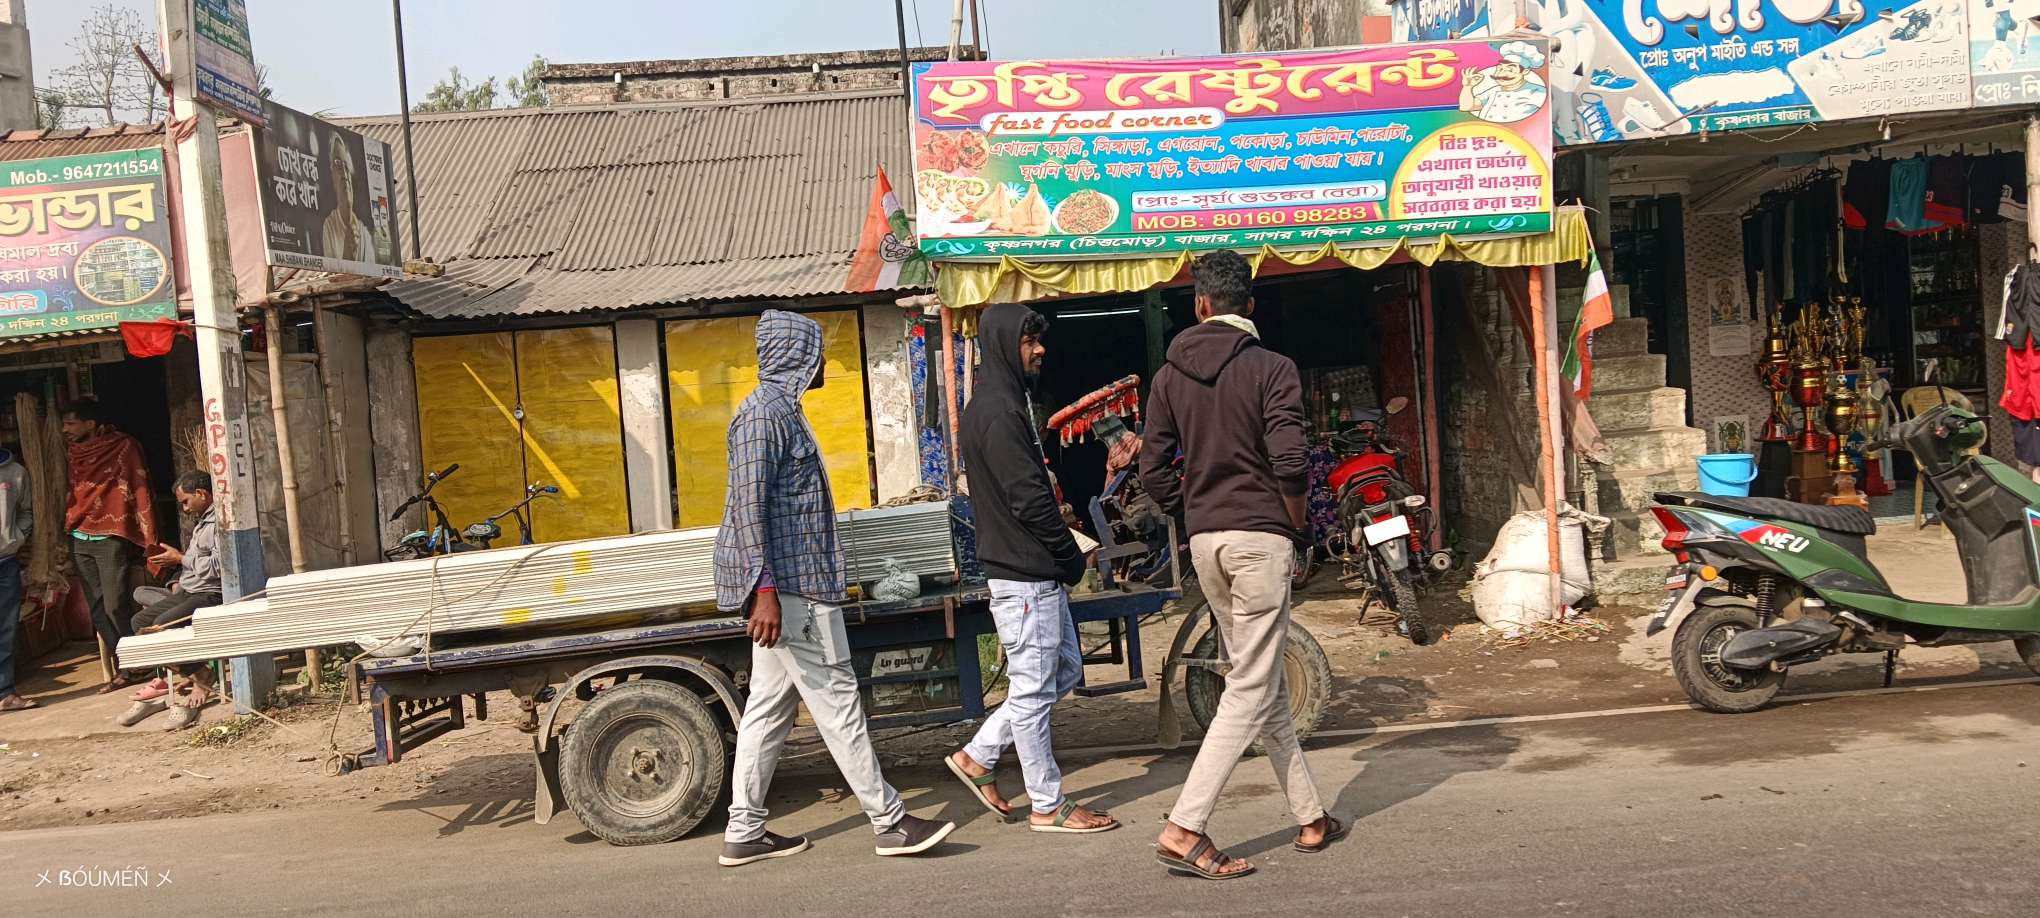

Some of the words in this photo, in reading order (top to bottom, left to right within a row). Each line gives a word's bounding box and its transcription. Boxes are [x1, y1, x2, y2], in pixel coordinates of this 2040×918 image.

[1672, 43, 1707, 71] অনুপ
[1710, 35, 1747, 61] মাইতি
[923, 62, 1088, 121] তৃপ্তি
[987, 112, 1046, 137] fast
[1049, 112, 1115, 137] food
[1121, 113, 1213, 129] corner
[990, 141, 1040, 157] এখানে
[1417, 157, 1472, 172] এখানে
[1476, 150, 1528, 170] অর্ডার
[10, 169, 59, 185] Mob.-
[63, 159, 159, 181] 9647211554
[1105, 162, 1145, 178] মাংস
[1187, 154, 1243, 177] ইত্যাদি
[1245, 156, 1290, 172] খাবার
[1294, 153, 1341, 170] পাওয়া
[298, 181, 319, 210] খান
[1402, 174, 1474, 197] অনুযায়ী
[1478, 174, 1544, 190] খাওয়ার
[1137, 214, 1205, 230] MOB:
[1212, 211, 1286, 227] 80160
[1293, 206, 1368, 223] 98283
[1402, 198, 1471, 215] সরবরাহ
[1474, 197, 1507, 212] করা
[1244, 230, 1292, 242] সাগর
[1360, 225, 1388, 236] ২৪
[1396, 219, 1461, 232] পরগনা
[50, 316, 69, 328] ২৪
[1759, 529, 1810, 553] NEU
